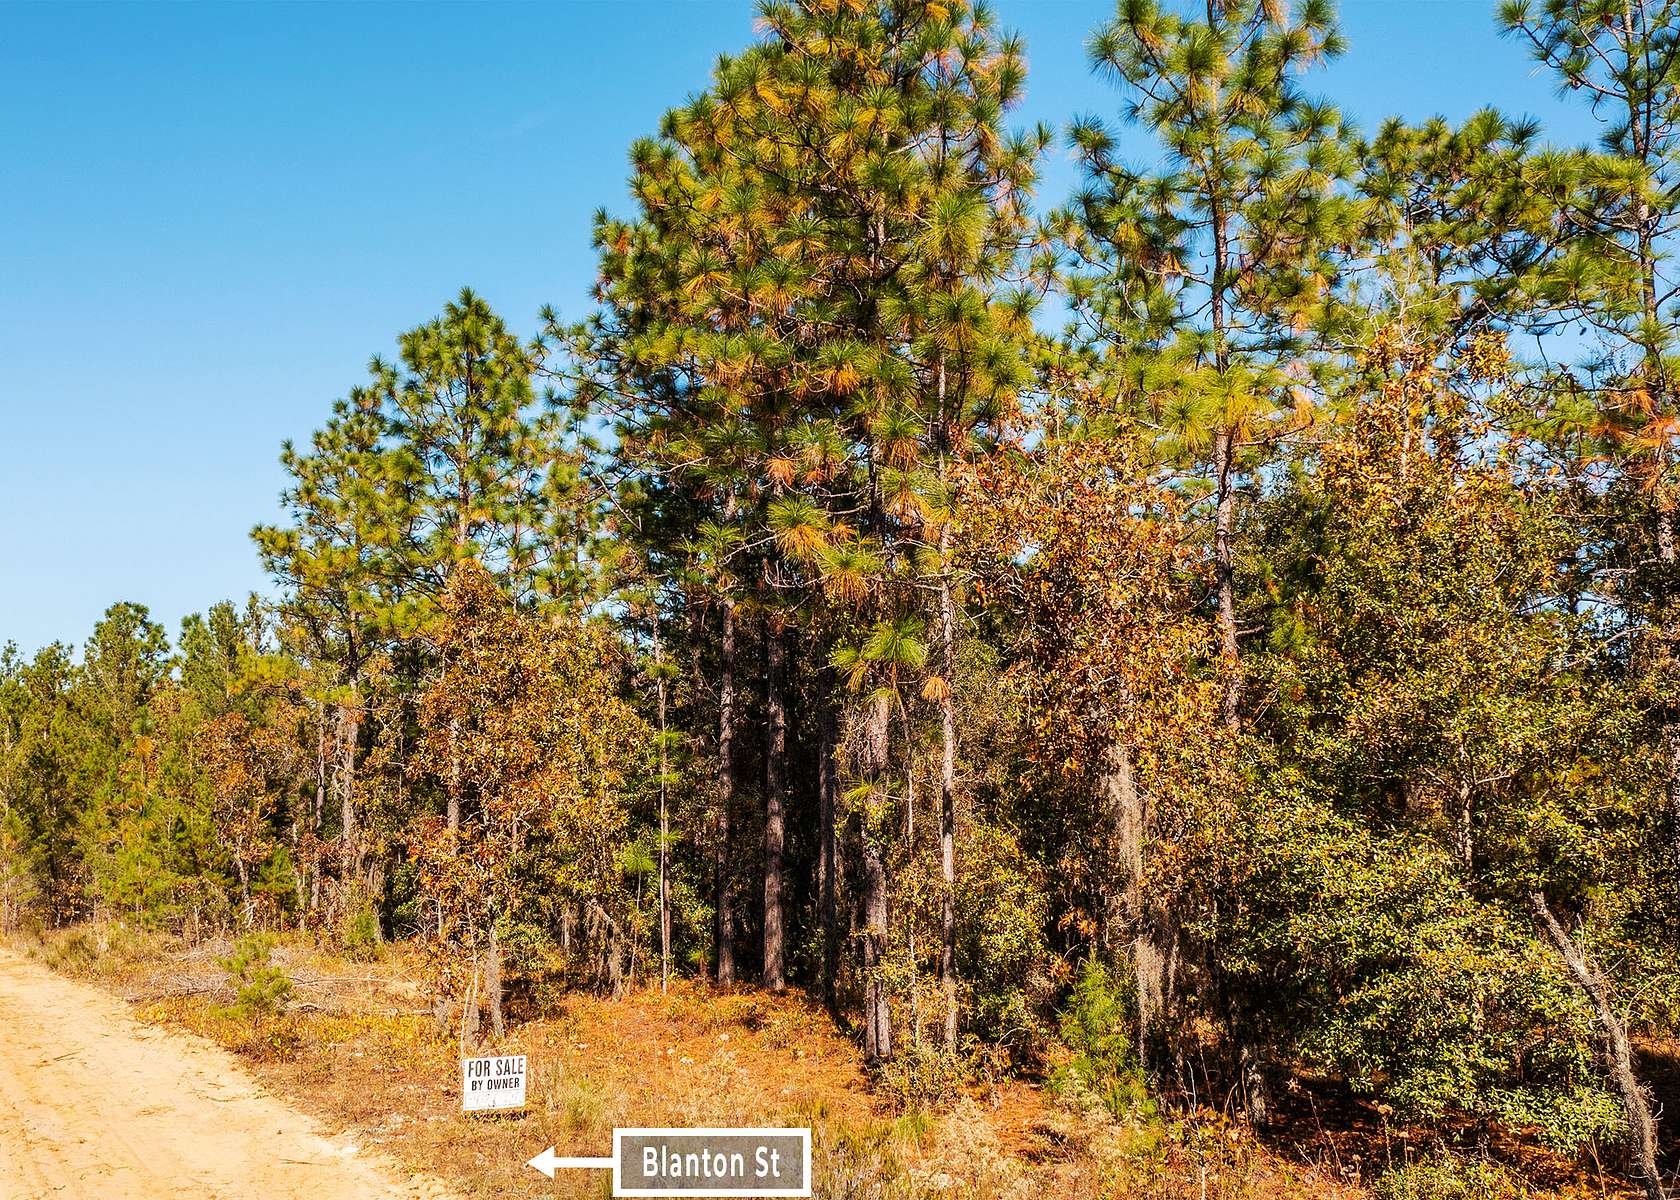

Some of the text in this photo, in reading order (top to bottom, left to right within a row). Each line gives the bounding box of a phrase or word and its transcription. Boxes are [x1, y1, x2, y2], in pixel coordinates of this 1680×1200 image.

[468, 1058, 523, 1077] FOR SALE
[471, 1077, 520, 1091] BY OWNER
